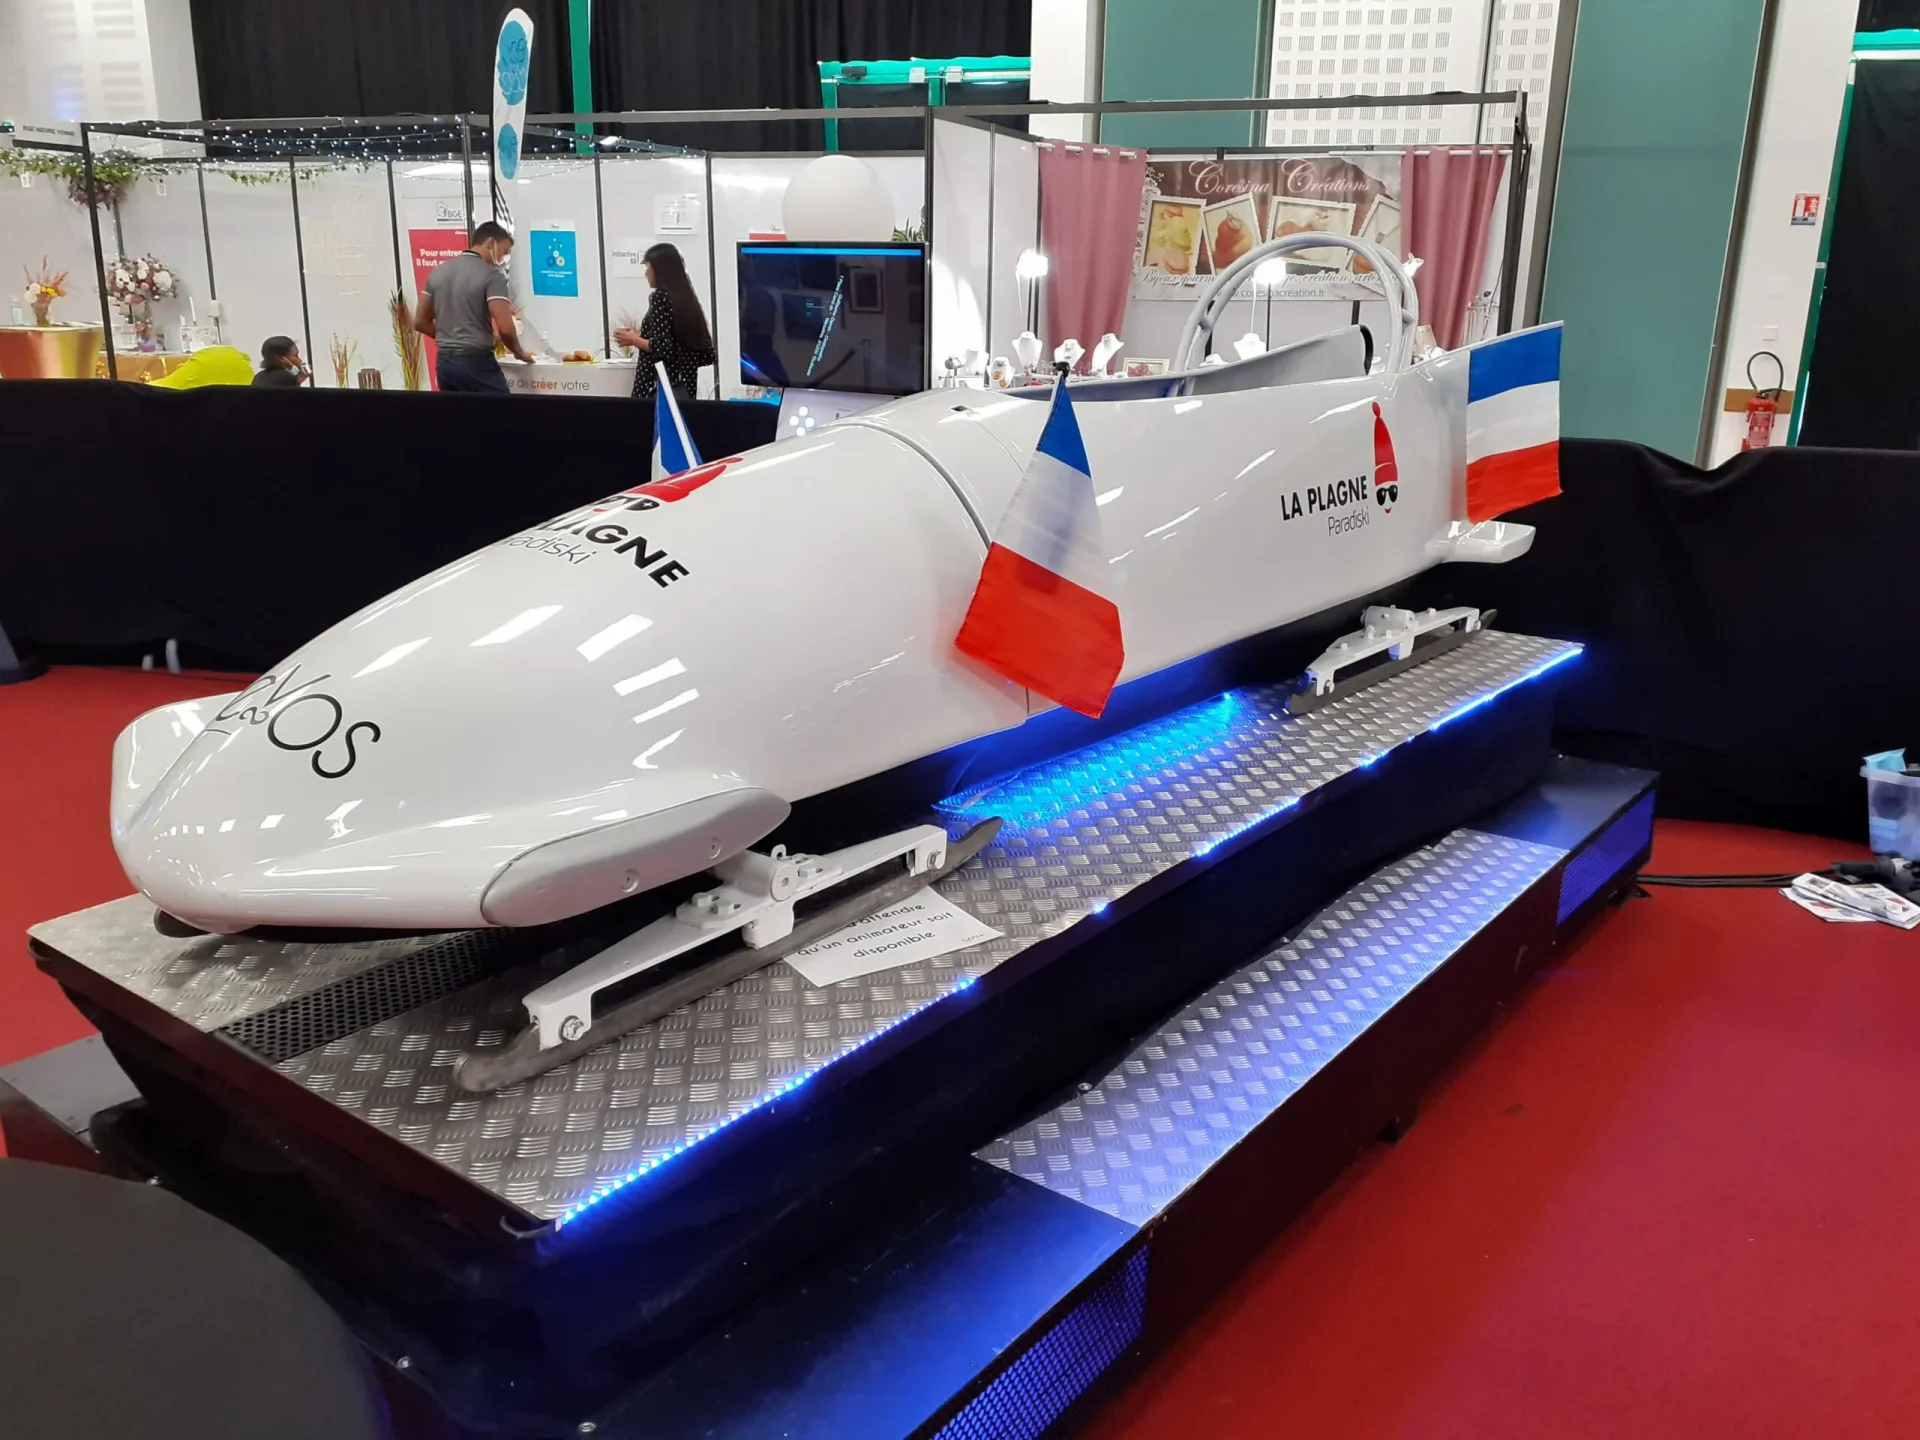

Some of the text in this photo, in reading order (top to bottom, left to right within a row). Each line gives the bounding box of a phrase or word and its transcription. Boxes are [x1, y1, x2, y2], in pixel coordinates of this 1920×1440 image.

[531, 378, 557, 389] créer
[561, 380, 590, 391] votre
[1280, 475, 1368, 521] LA PLAGNE
[1327, 506, 1370, 536] Paradiski
[797, 911, 954, 956] qu'un animateur soit
[853, 931, 936, 958] disponible
